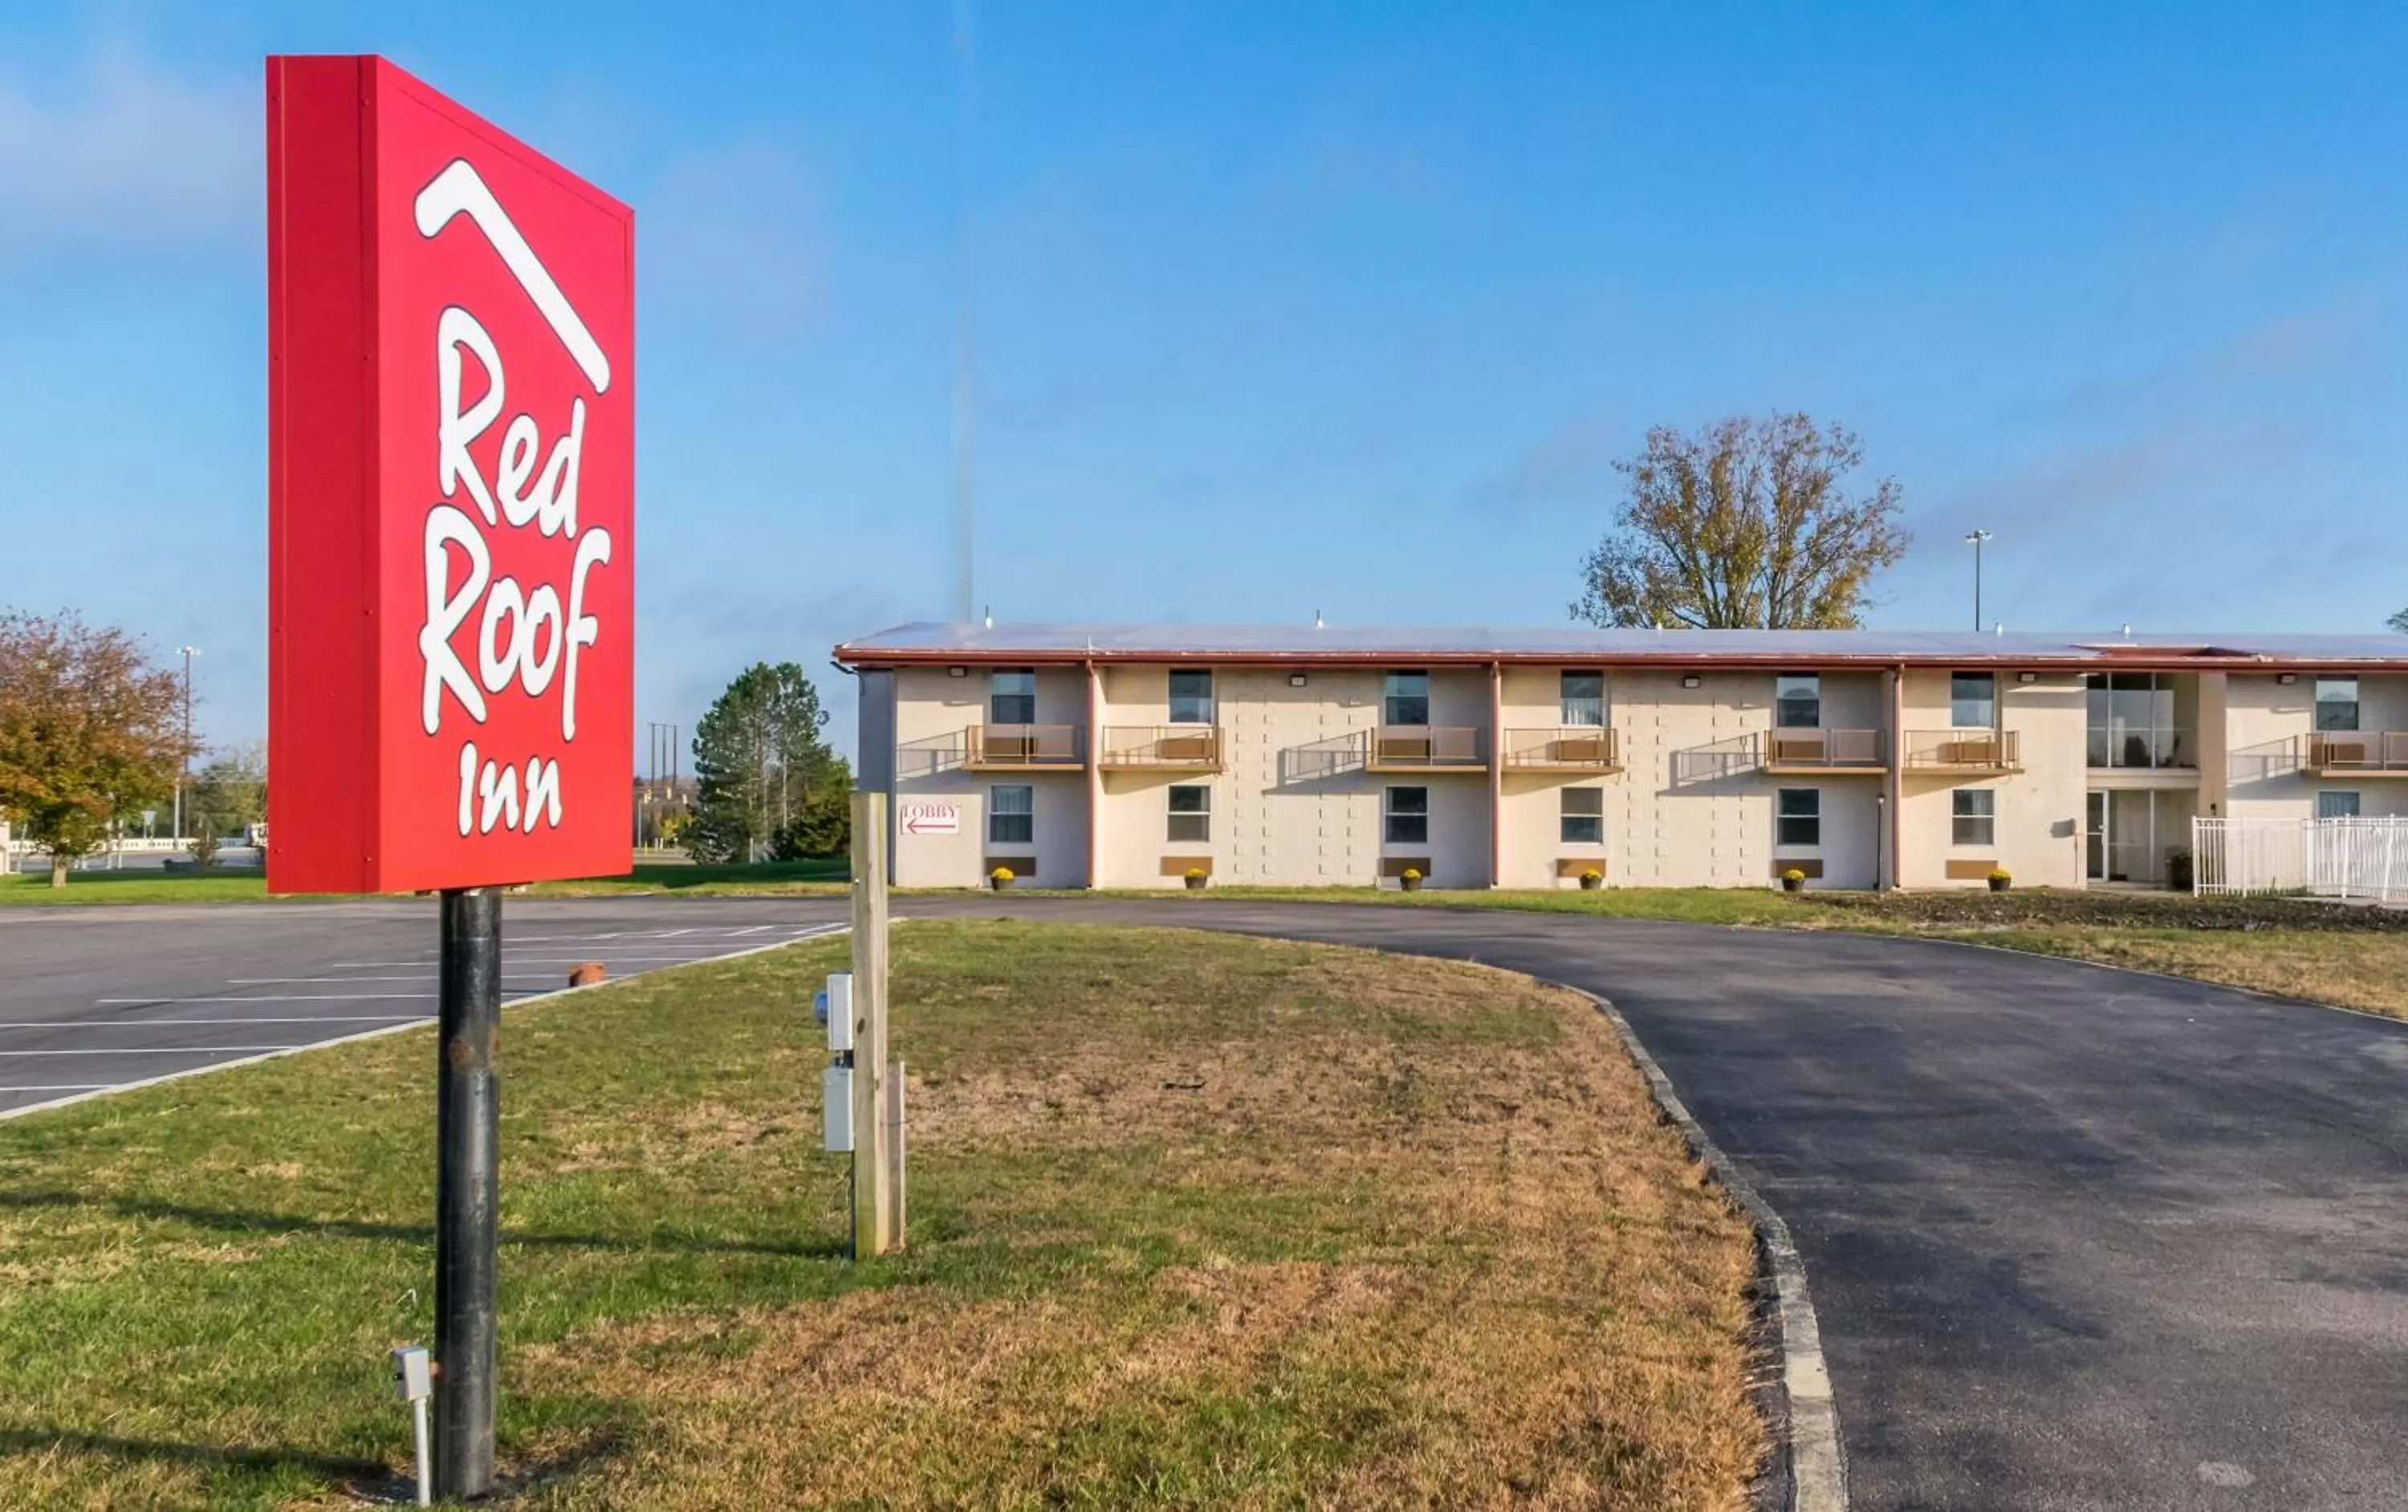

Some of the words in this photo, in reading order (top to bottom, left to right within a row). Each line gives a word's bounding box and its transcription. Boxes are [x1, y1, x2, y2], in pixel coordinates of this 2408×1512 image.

[437, 307, 586, 539] Red
[419, 505, 612, 742] Roof
[458, 742, 563, 836] Inn
[903, 805, 956, 818] LOBBY
